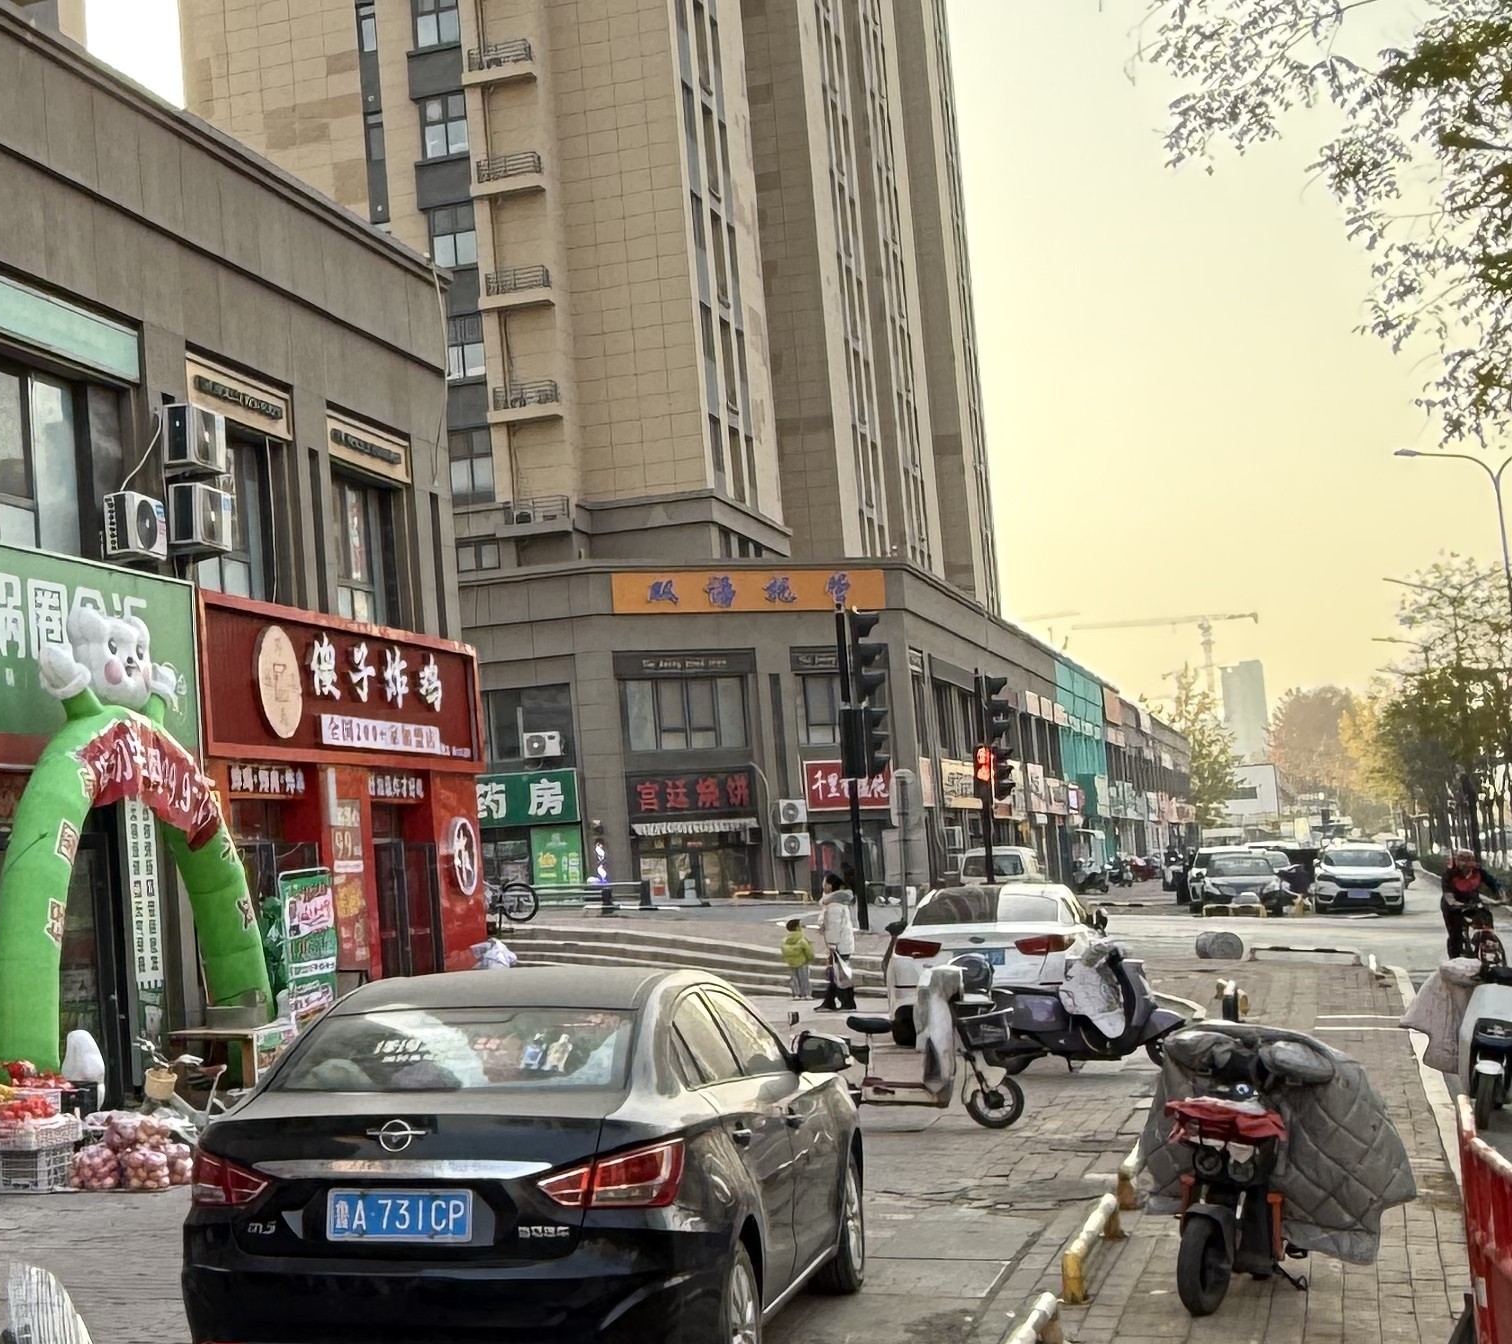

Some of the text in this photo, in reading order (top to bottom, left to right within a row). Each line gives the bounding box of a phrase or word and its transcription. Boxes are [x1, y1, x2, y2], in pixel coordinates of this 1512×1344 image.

[475, 778, 565, 819] 药房
[637, 773, 750, 812] 宫廷烧饼
